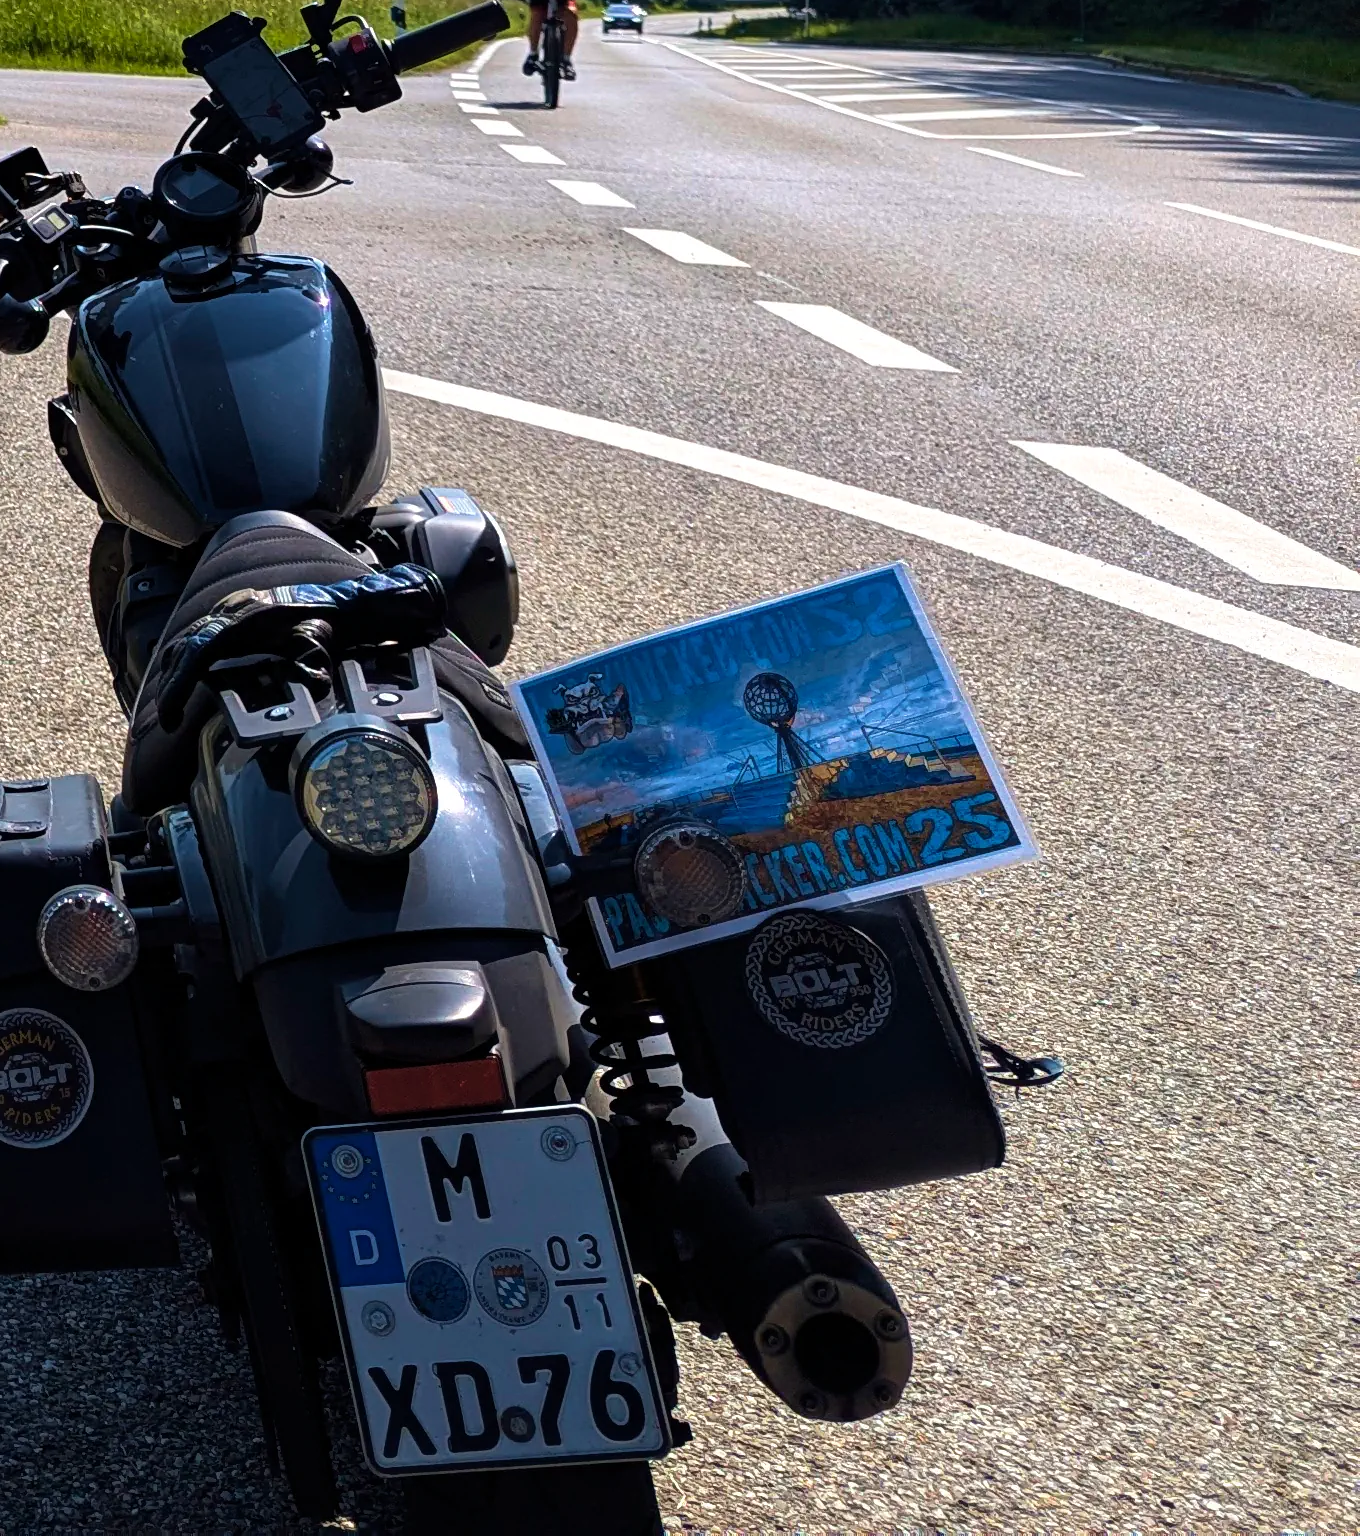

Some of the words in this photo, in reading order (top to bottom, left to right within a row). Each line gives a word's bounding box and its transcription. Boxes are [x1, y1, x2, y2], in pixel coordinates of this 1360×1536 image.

[905, 792, 1013, 866] 25
[768, 931, 845, 965] GERMAN
[769, 963, 862, 999] BOLT
[849, 984, 872, 997] 950
[801, 1003, 866, 1031] RIDERS
[4, 1103, 61, 1126] RIDERS
[421, 1132, 492, 1223] M
[349, 1229, 380, 1266] D
[546, 1233, 602, 1272] 03
[563, 1292, 613, 1331] 11
[367, 1360, 501, 1459] XD
[517, 1349, 646, 1447] 76
